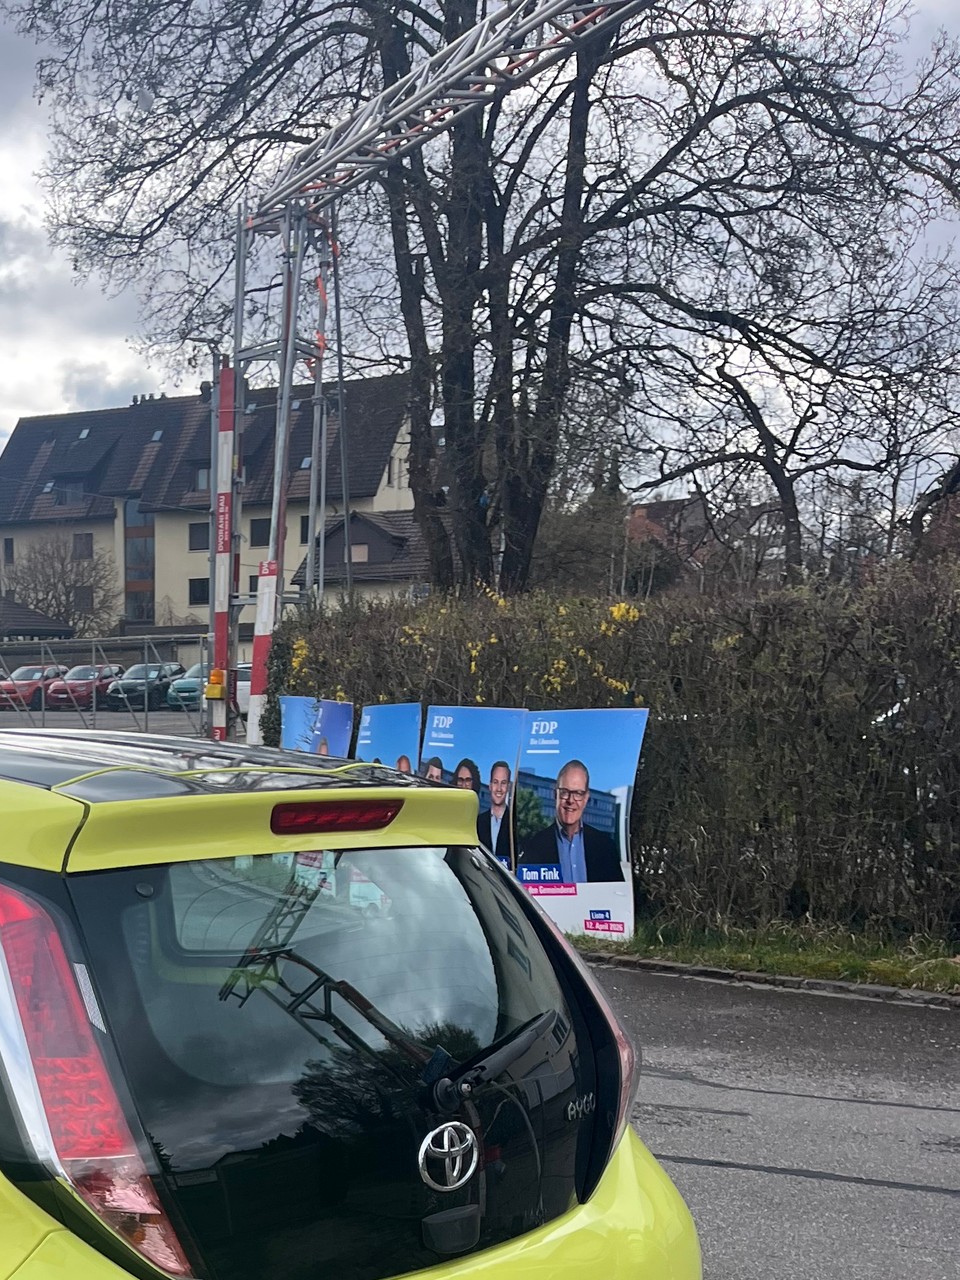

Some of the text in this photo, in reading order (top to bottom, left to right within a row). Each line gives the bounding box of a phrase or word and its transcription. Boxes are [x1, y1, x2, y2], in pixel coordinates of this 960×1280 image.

[433, 715, 453, 728] FDP
[531, 721, 558, 735] FDP
[522, 867, 560, 880] Tom Fink
[586, 921, 595, 929] 12.
